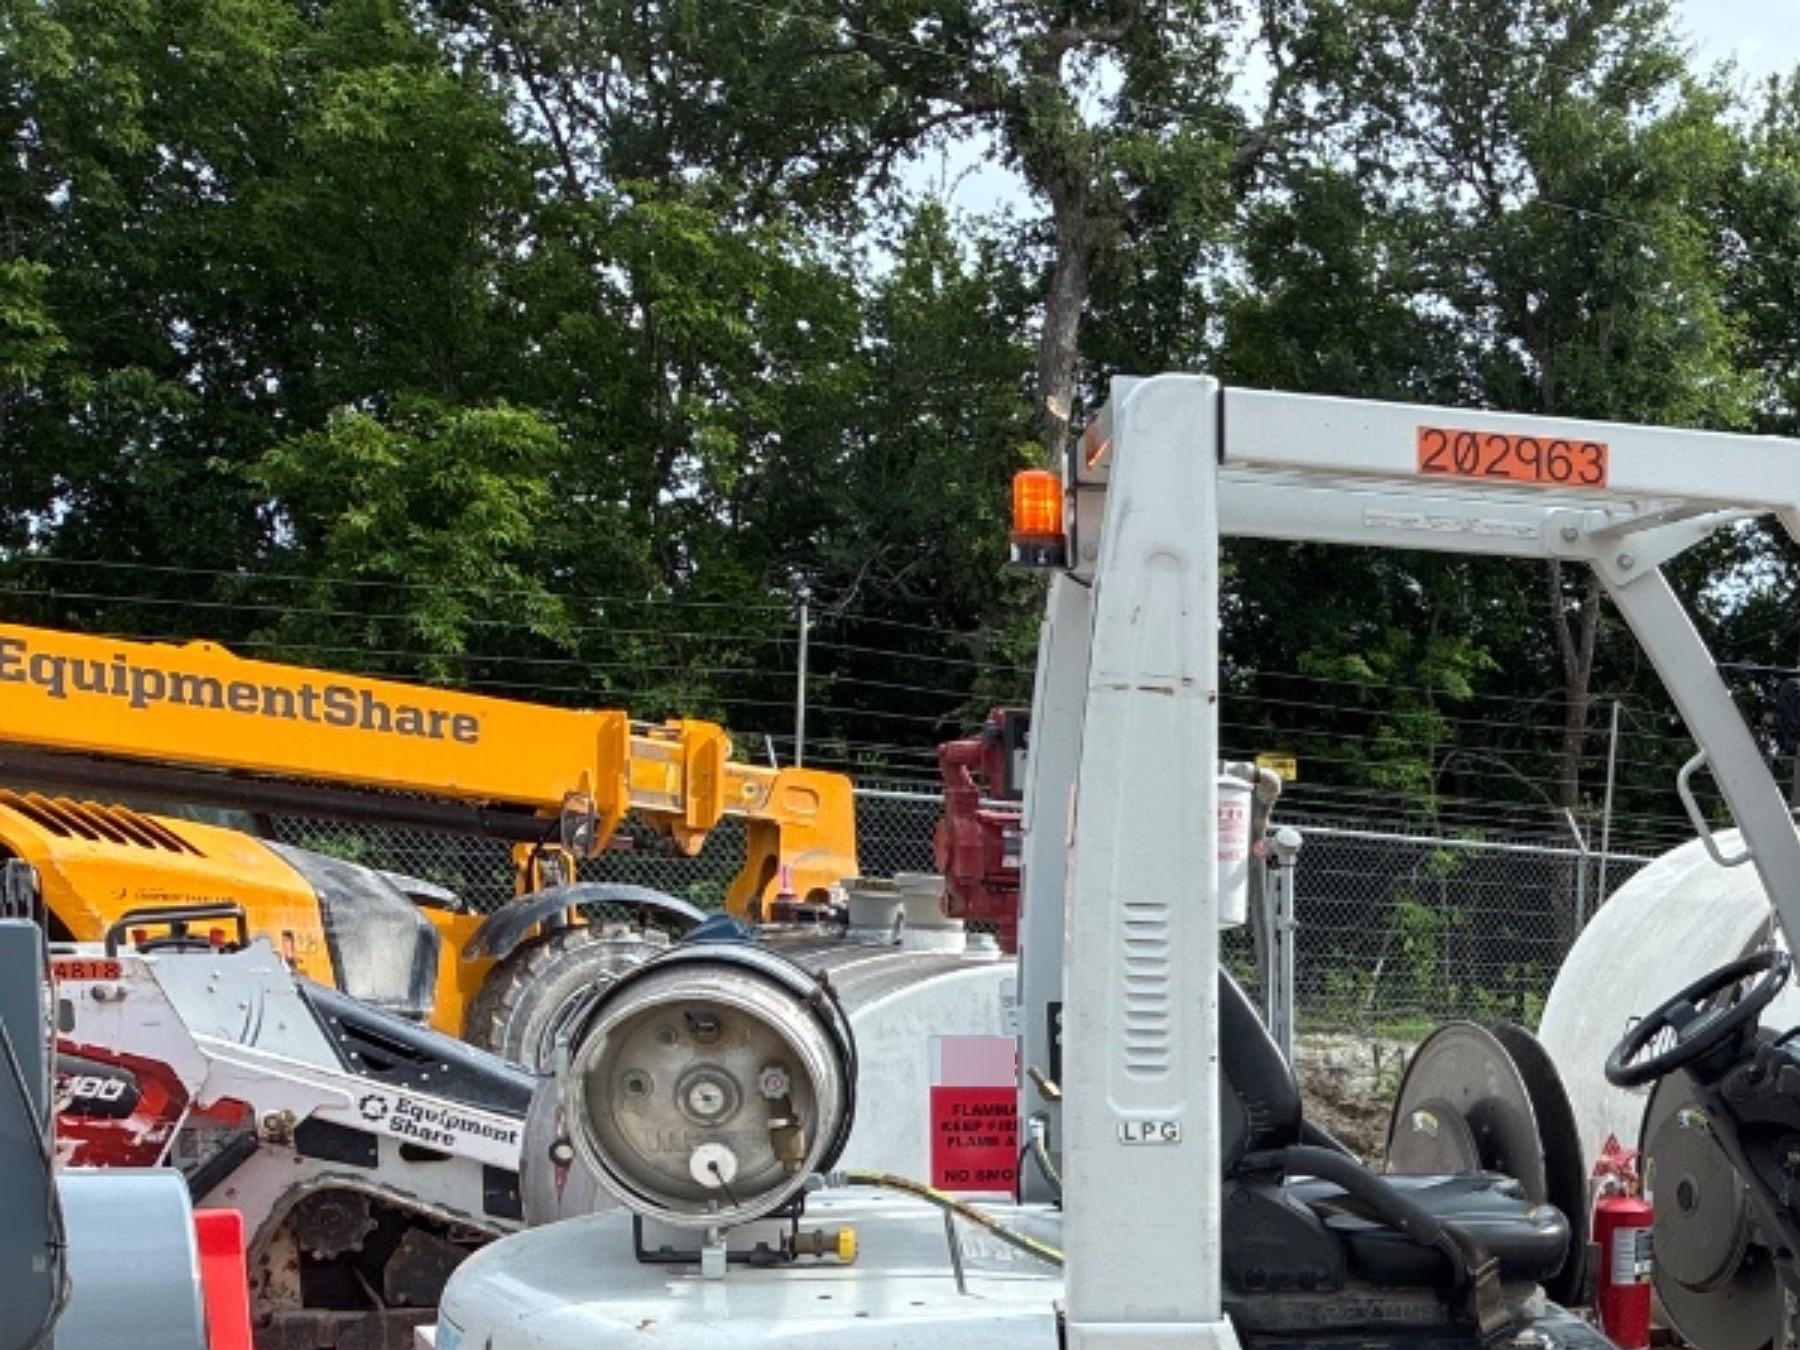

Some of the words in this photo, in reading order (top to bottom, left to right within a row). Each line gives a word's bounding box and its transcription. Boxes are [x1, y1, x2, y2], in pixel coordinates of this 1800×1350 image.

[1420, 428, 1604, 485] 202963
[0, 637, 480, 744] EquipmentShare
[389, 1116, 456, 1147] Share
[394, 1097, 519, 1144] Equipment
[1124, 1121, 1177, 1141] LPG
[944, 1169, 970, 1182] NO
